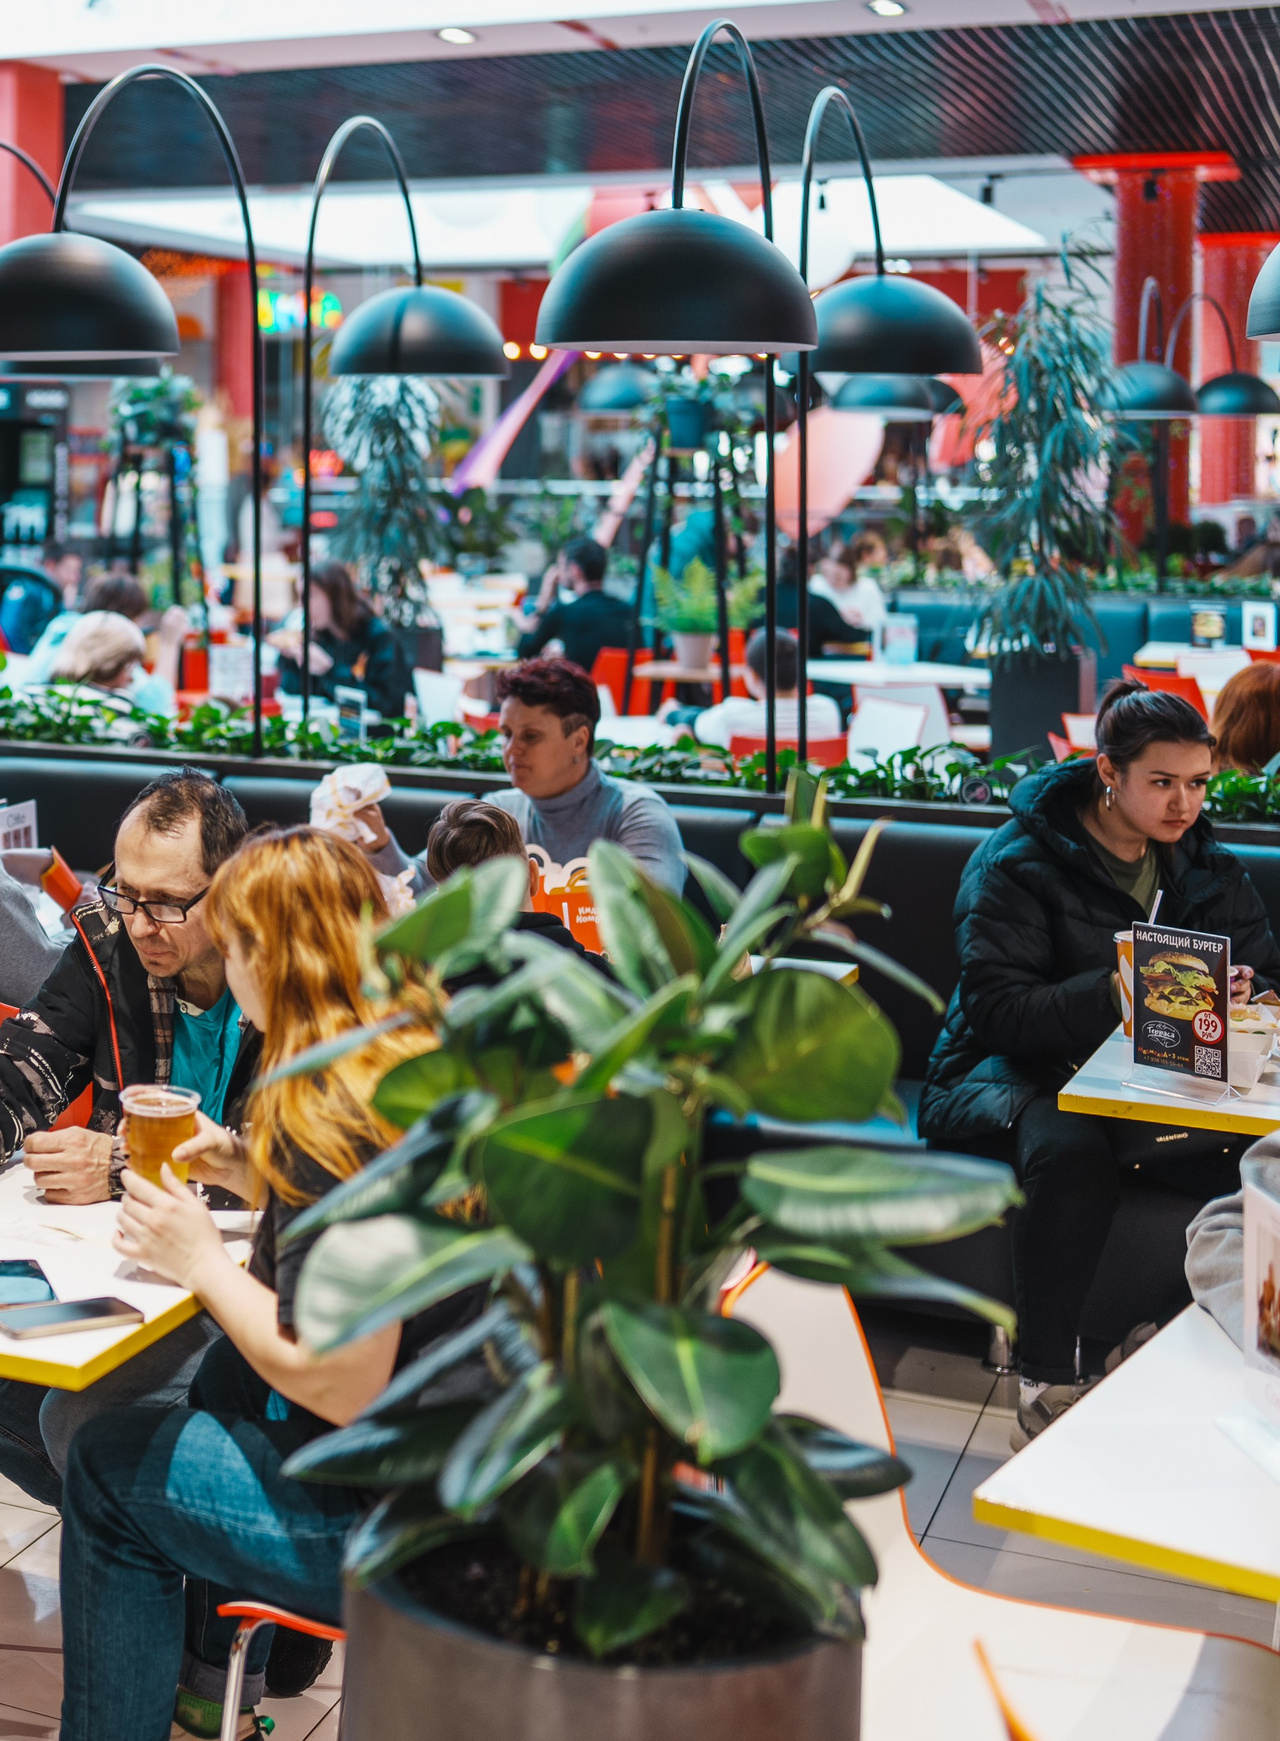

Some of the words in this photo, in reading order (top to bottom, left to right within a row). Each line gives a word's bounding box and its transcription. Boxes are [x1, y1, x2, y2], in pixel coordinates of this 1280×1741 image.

[1136, 930, 1190, 948] НАСТОЯЩИЙ
[1193, 939, 1223, 953] БУРГЕР
[1147, 1026, 1175, 1039] Терраса
[1198, 1018, 1218, 1033] 199
